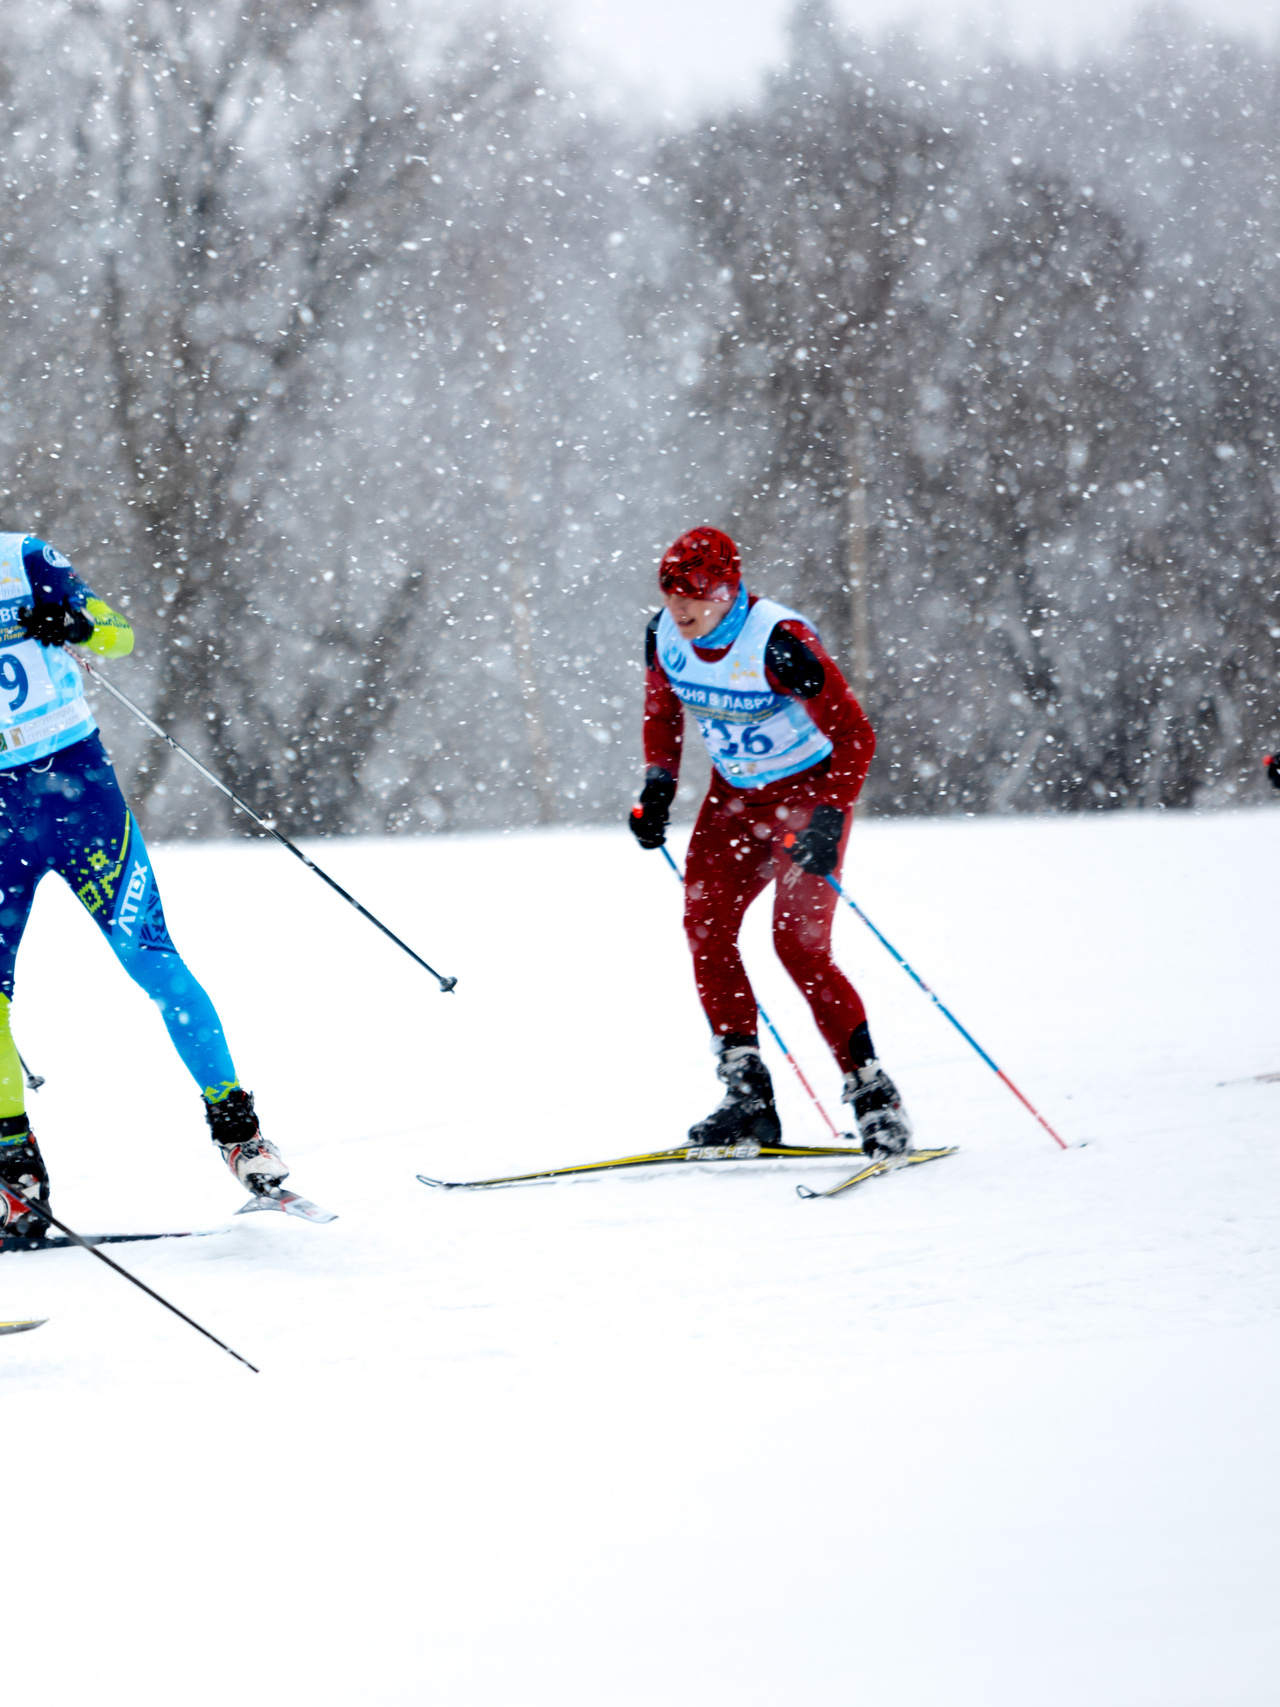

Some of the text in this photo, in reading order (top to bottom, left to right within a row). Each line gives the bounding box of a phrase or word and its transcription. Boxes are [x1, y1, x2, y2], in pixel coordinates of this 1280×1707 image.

[708, 692, 720, 706] В
[722, 693, 776, 711] ЛАВРУ
[686, 1144, 762, 1160] FISCHER
